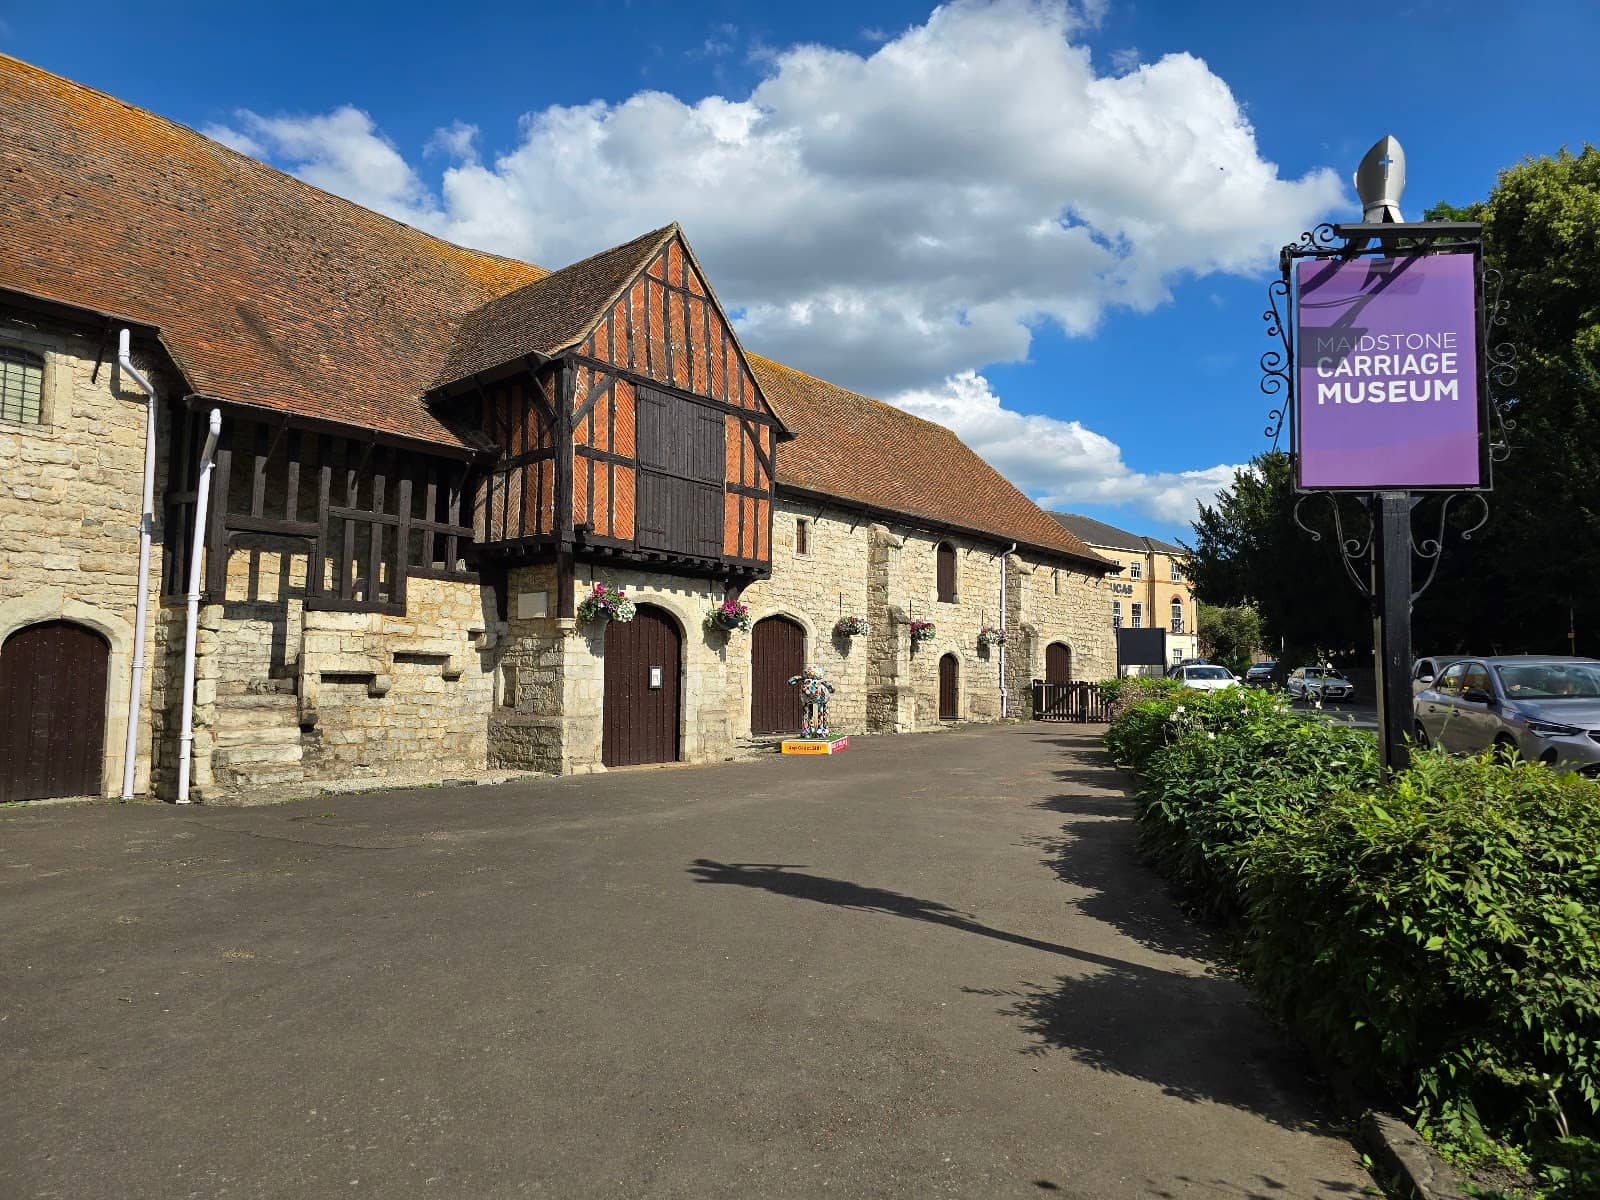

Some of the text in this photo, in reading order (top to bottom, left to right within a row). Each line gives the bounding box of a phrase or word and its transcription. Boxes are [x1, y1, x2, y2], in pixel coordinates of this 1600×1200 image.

[1317, 332, 1457, 352] MAIDSTONE
[1317, 352, 1458, 378] CARRIAGE
[1317, 379, 1459, 405] MUSEUM
